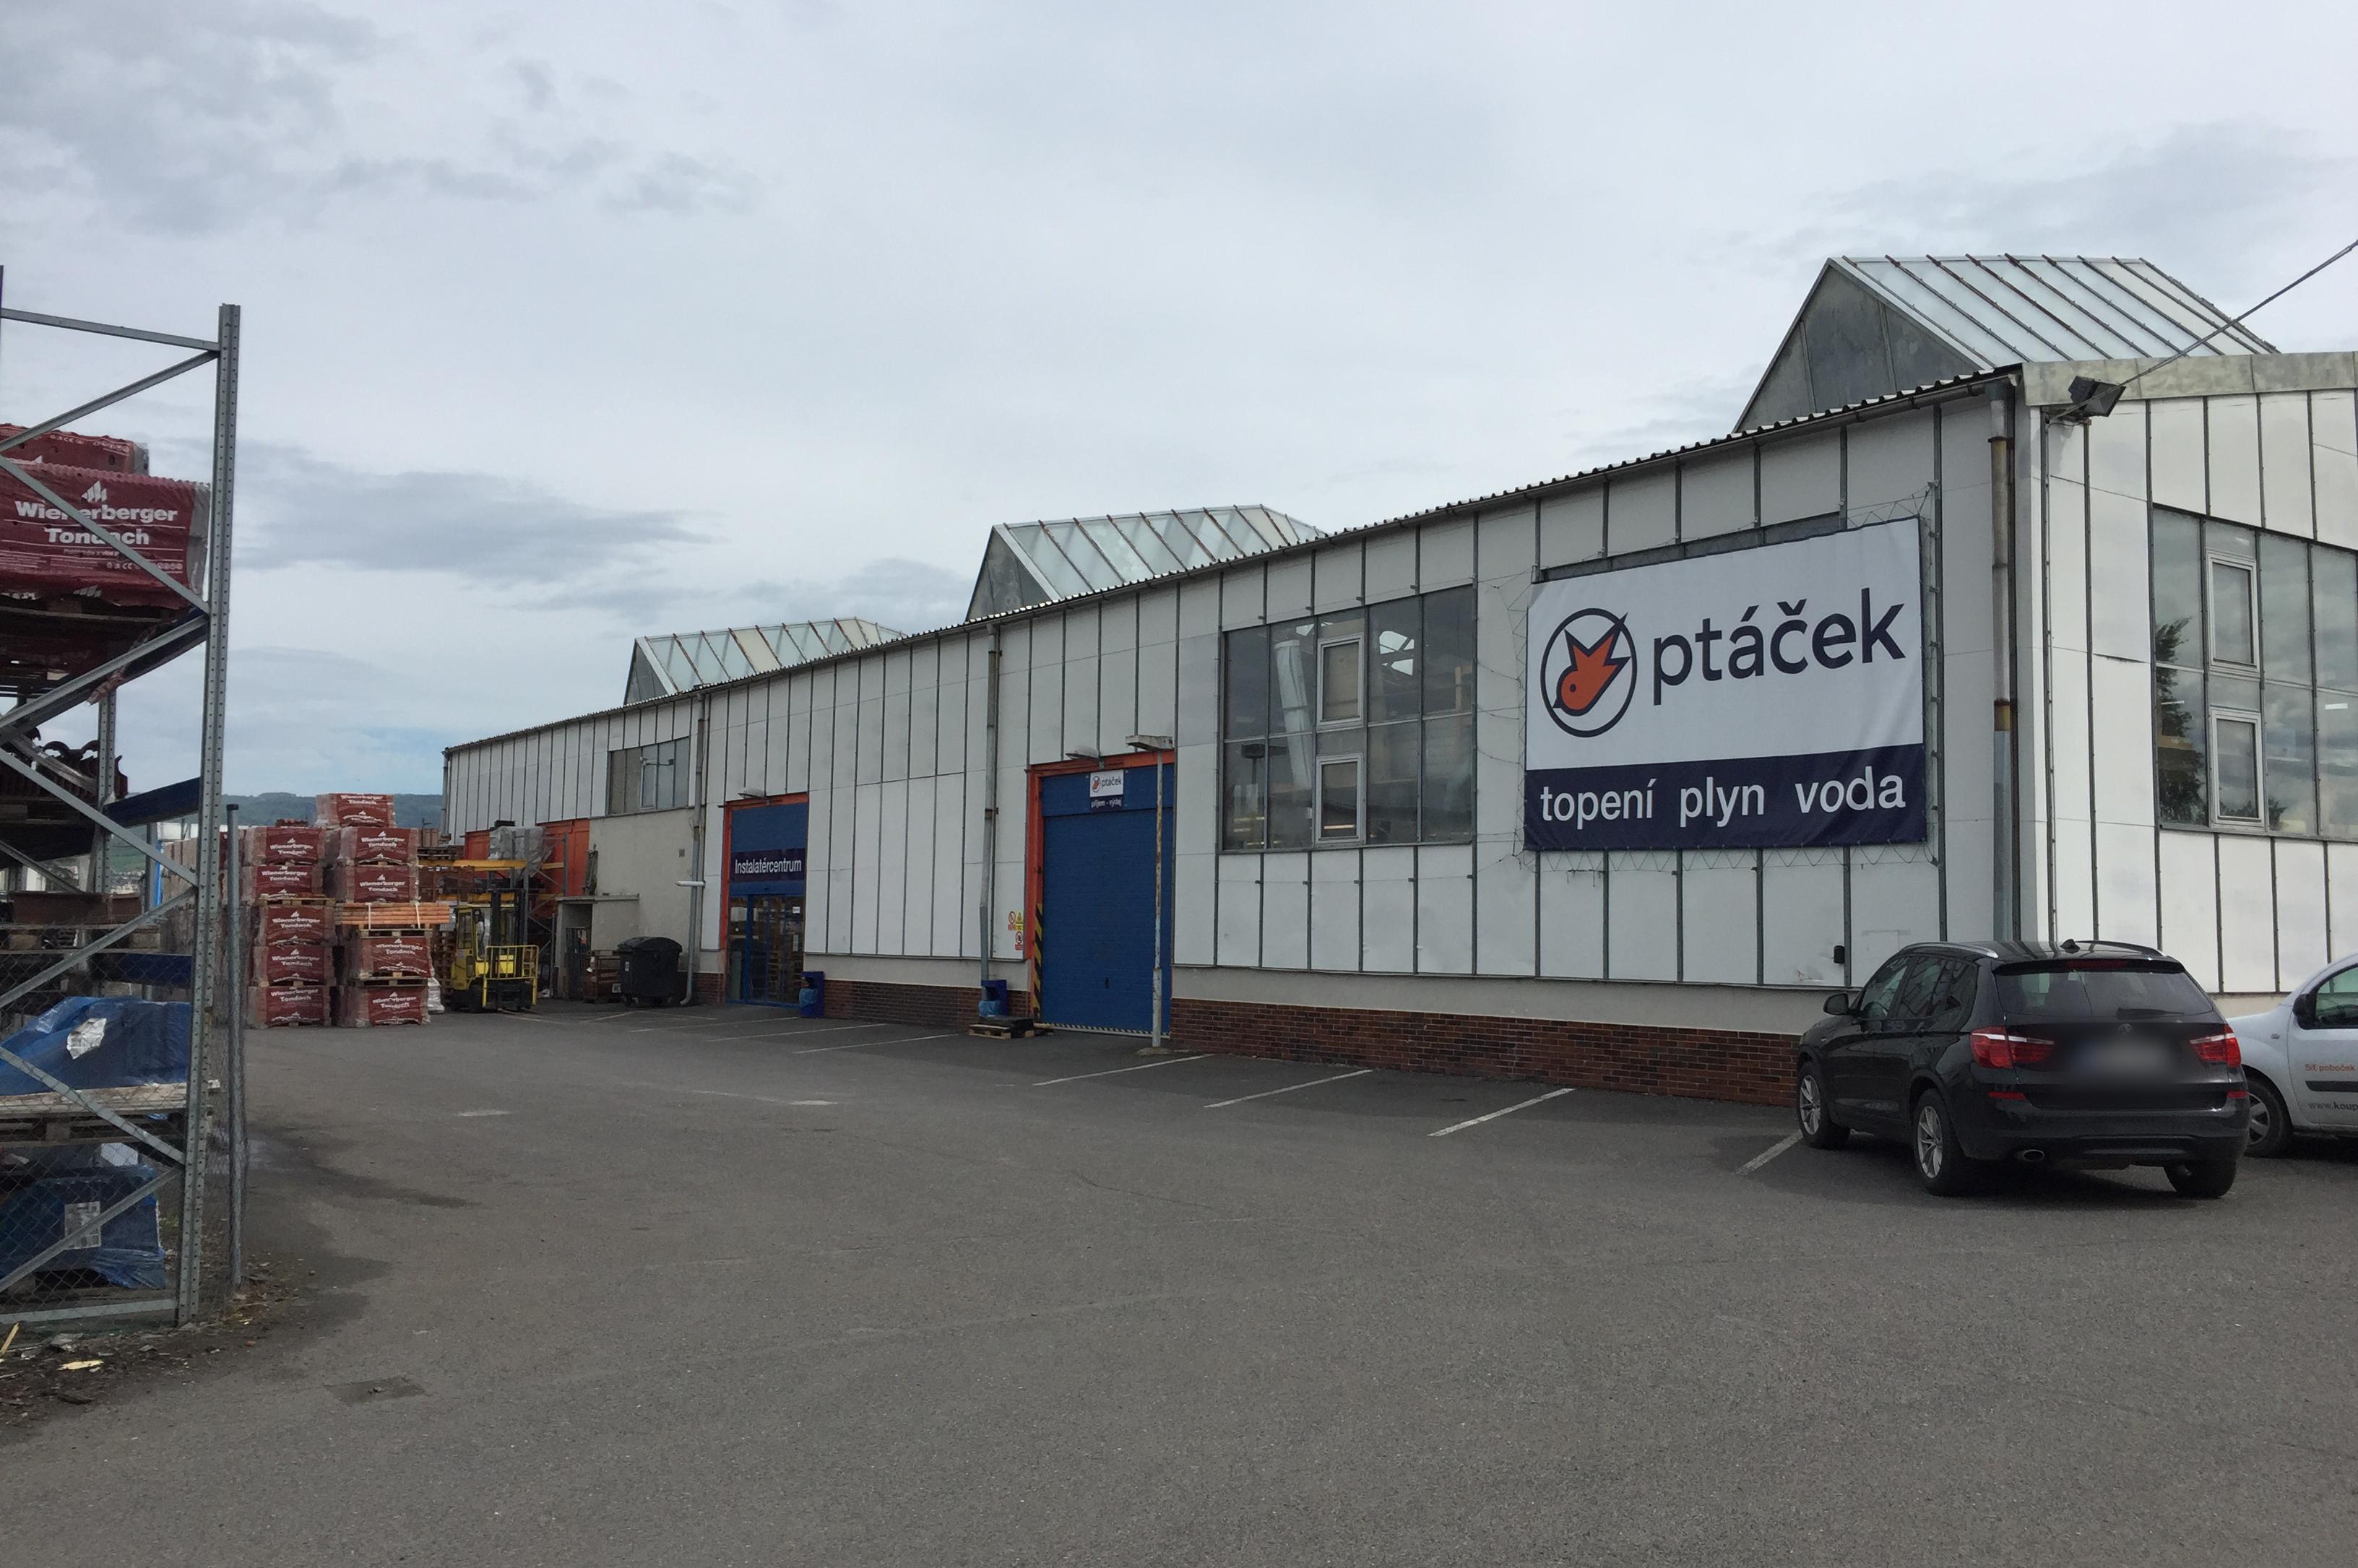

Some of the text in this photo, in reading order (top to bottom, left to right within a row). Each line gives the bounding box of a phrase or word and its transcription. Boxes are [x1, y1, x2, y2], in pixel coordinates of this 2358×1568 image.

[1653, 588, 1906, 706] ptáček
[1101, 776, 1122, 789] ptáček
[1540, 766, 1906, 829] topení plyn voda
[735, 857, 802, 874] Instalatércentrum
